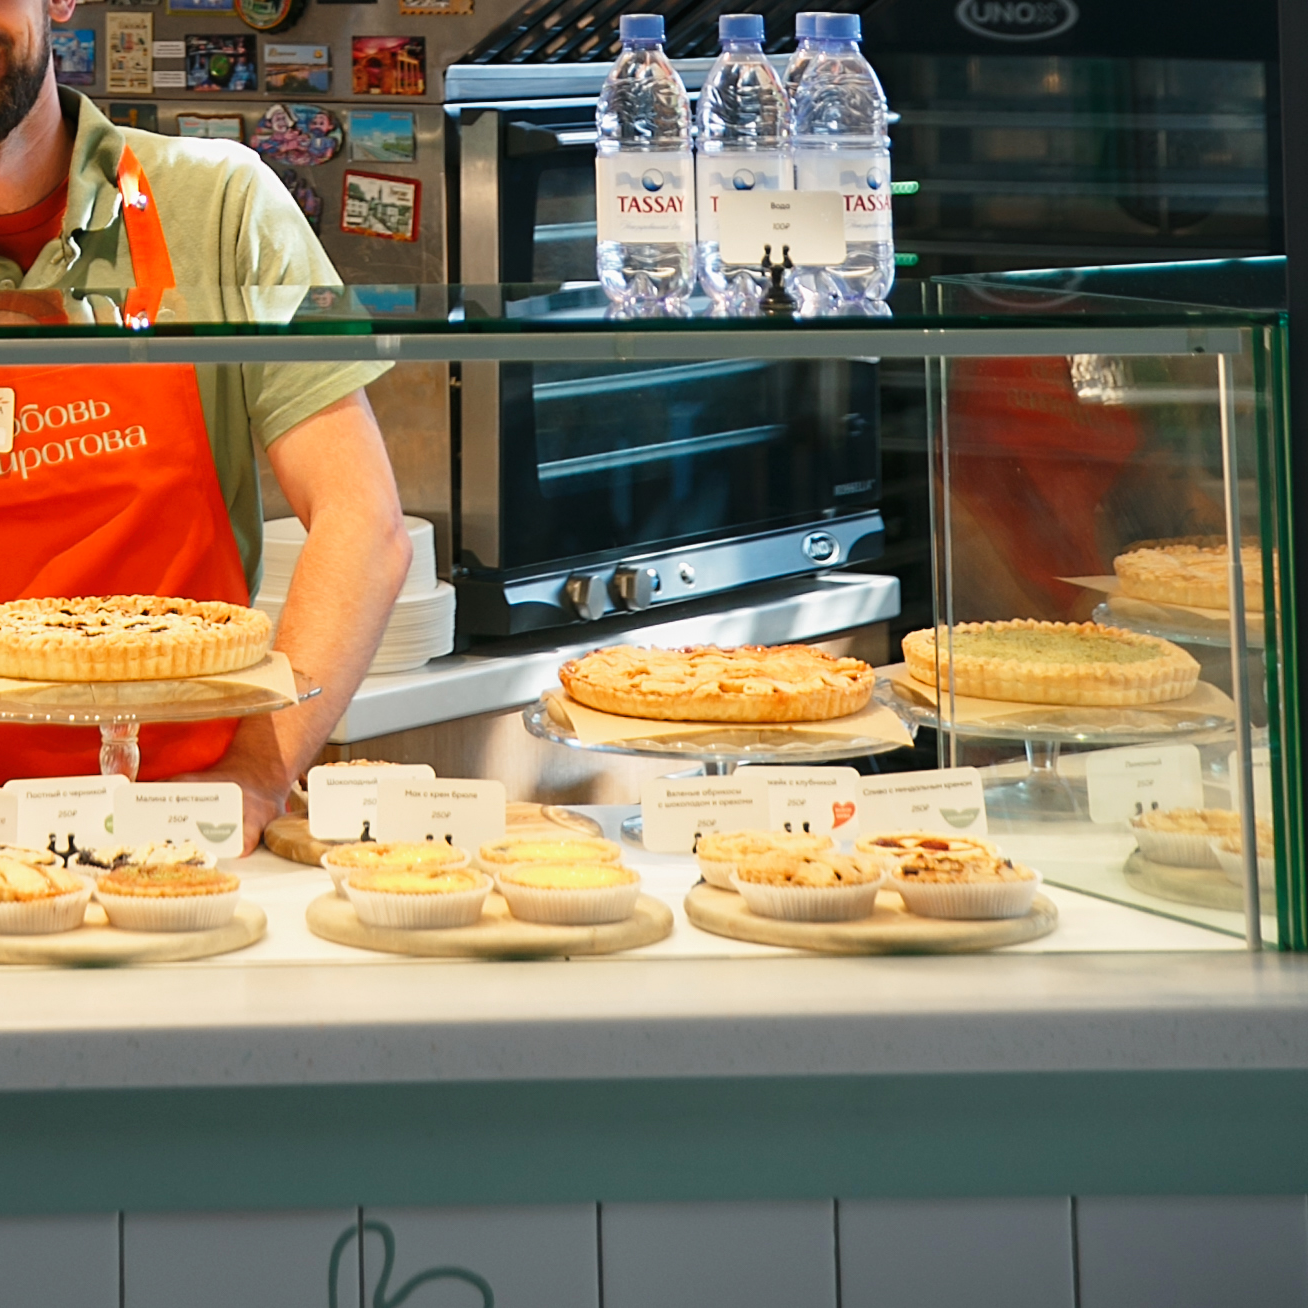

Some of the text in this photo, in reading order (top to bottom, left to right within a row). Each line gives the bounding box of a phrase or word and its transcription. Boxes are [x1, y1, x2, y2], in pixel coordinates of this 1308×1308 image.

[971, 1, 1059, 23] UNOX
[618, 196, 683, 213] TASSAY
[771, 202, 791, 213] Вода
[843, 194, 891, 212] TASSA
[136, 794, 166, 803] Малина
